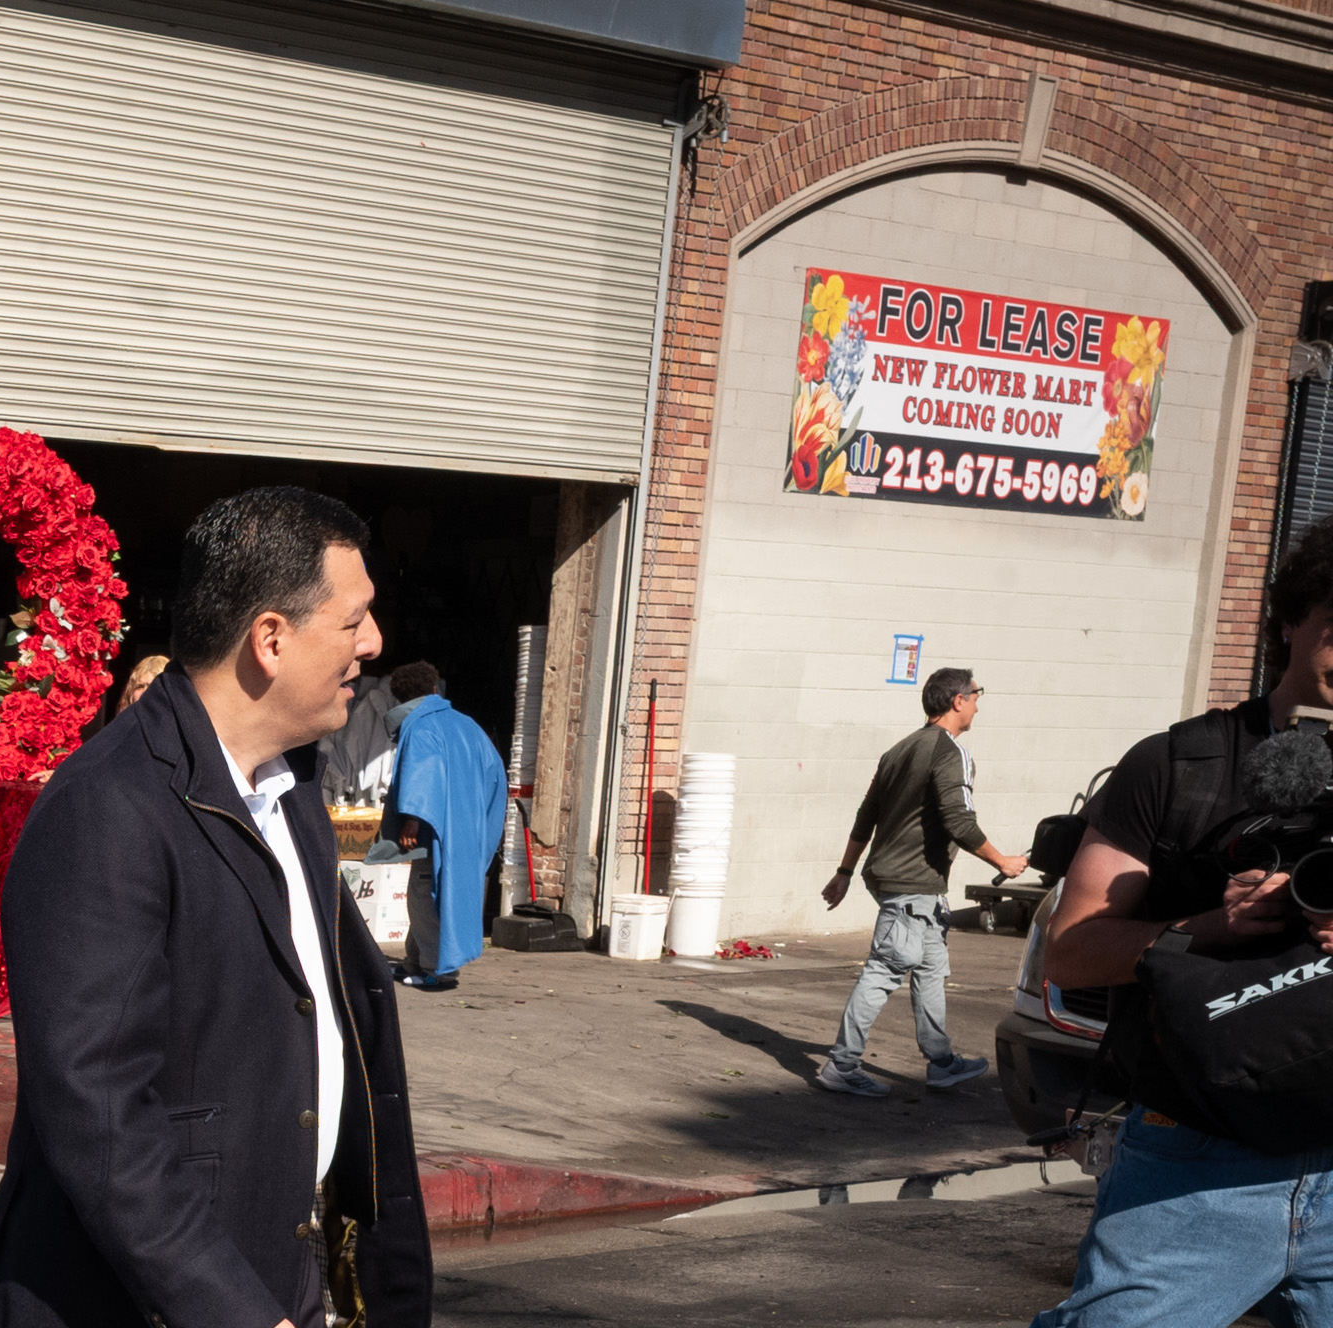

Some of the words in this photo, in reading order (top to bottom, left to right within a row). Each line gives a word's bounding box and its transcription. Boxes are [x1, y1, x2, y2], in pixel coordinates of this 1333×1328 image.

[876, 284, 965, 347] FOR
[977, 298, 1104, 365] LEASE
[872, 354, 928, 387] NEW
[932, 361, 1026, 399] FLOWER
[1032, 374, 1097, 406] MART
[902, 396, 996, 432] COMING
[1002, 407, 1063, 439] SOON
[881, 445, 1098, 506] 213-675-5969
